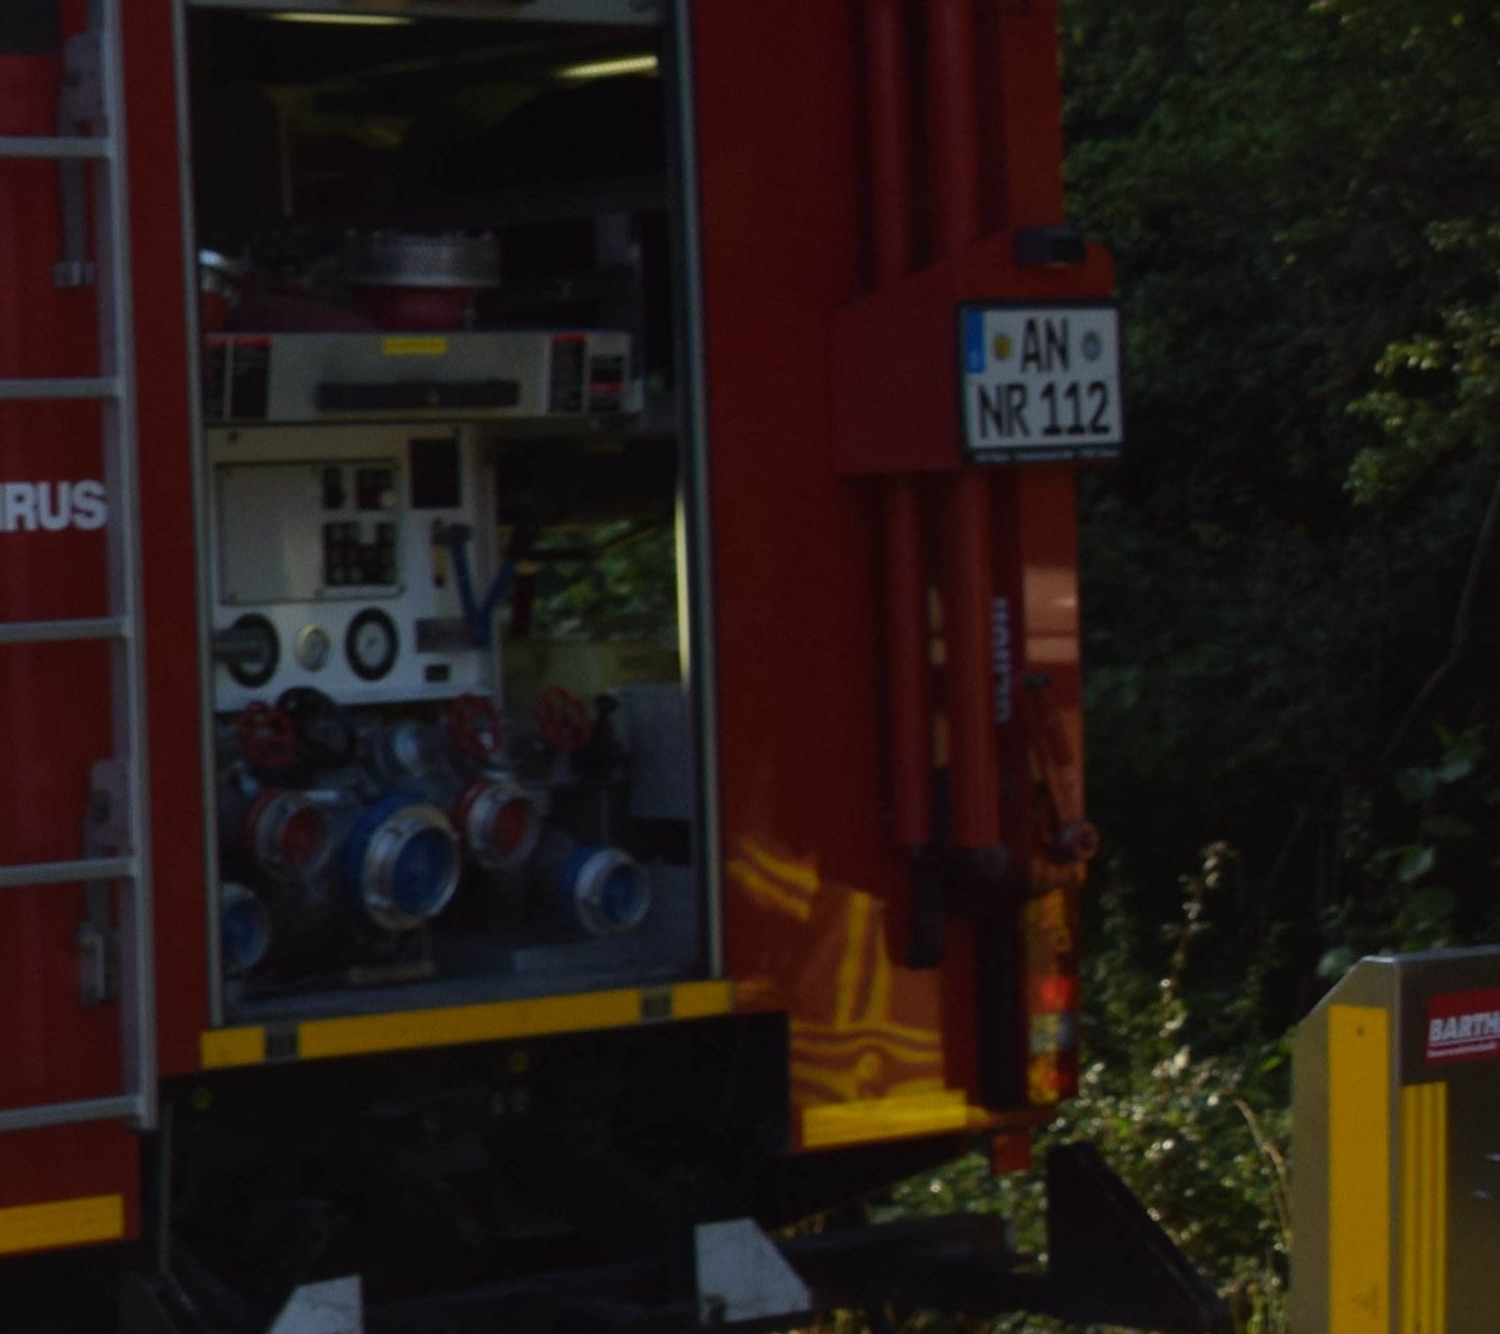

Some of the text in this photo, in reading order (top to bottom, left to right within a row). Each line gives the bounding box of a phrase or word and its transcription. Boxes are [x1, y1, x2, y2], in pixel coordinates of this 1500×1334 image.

[1021, 317, 1070, 373] AN
[978, 381, 1111, 439] NR 112
